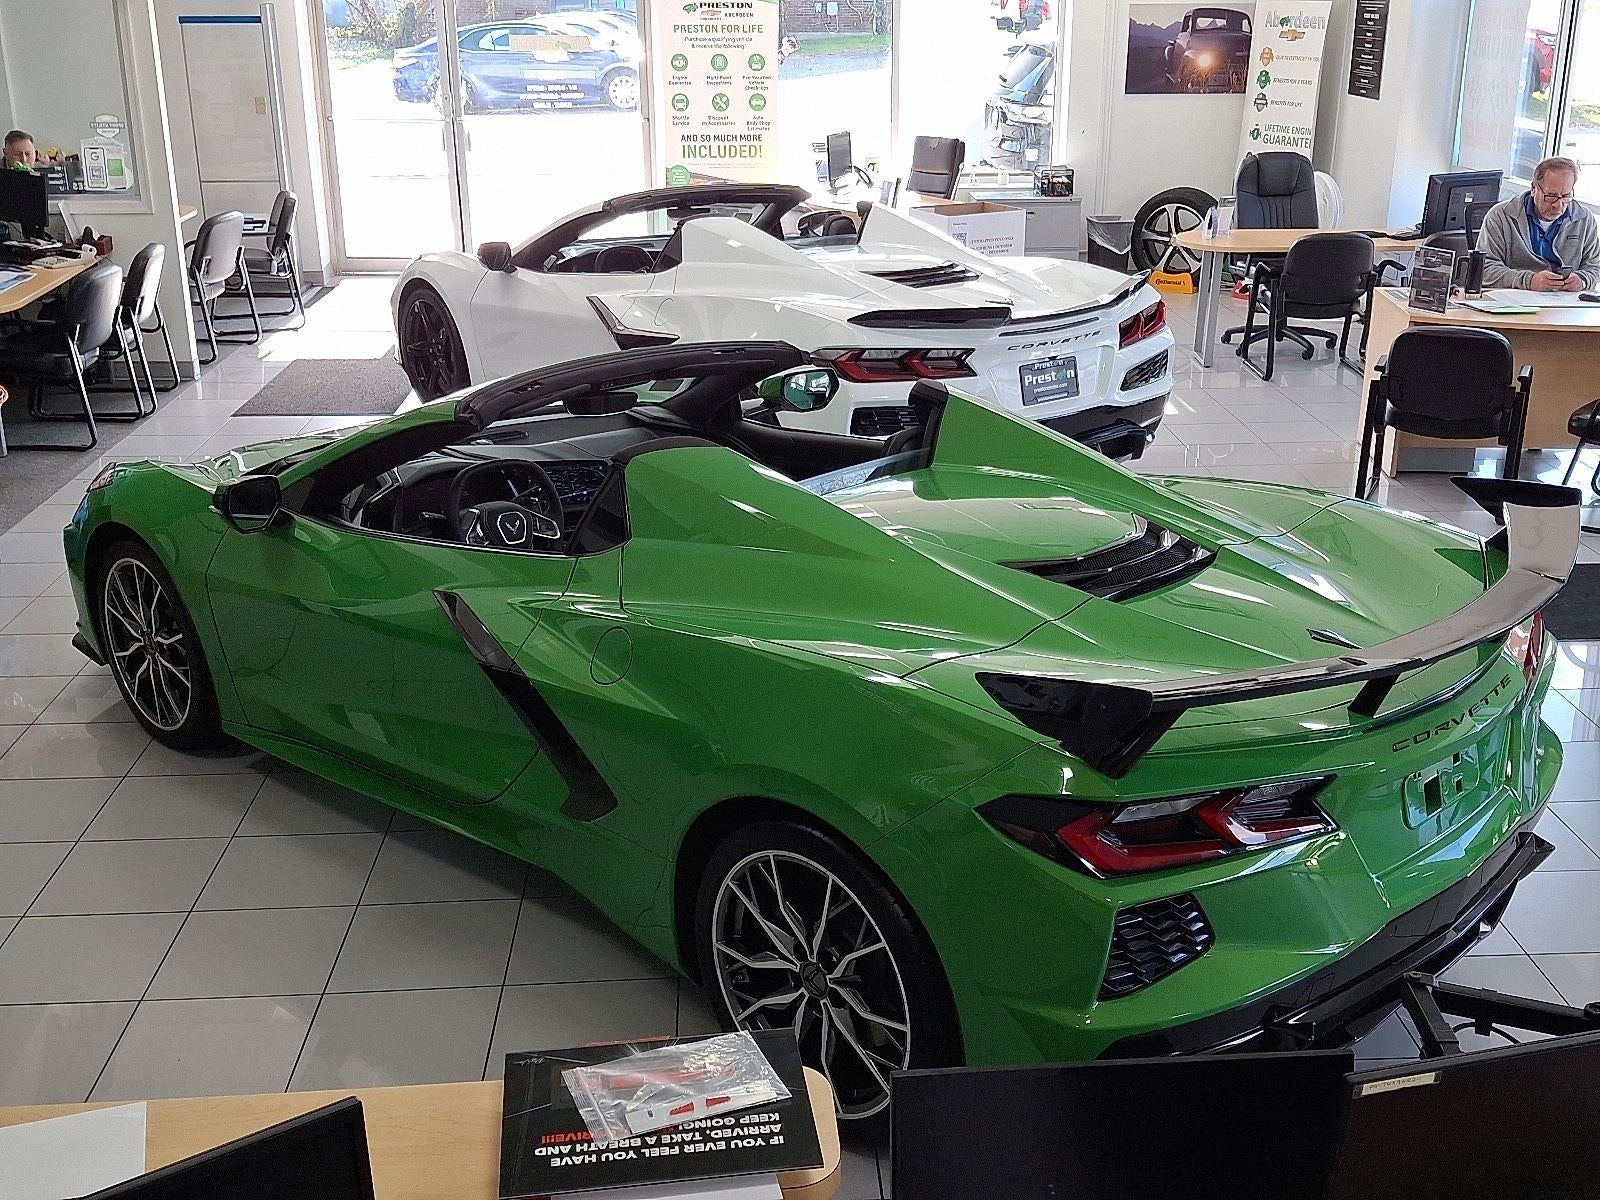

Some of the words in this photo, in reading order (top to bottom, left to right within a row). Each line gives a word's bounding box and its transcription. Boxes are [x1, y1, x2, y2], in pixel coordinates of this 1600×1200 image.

[1264, 10, 1326, 29] Abrdeen
[673, 24, 718, 34] PRESTON
[721, 24, 740, 34] FOR
[742, 24, 764, 34] LIFE
[1264, 124, 1291, 134] LIFETIME
[681, 134, 698, 142] AND
[700, 134, 711, 143] SO
[713, 134, 738, 142] MUCH
[739, 133, 763, 142] MORE
[682, 144, 762, 159] INCLUDED!
[1007, 330, 1101, 351] CORVETTE
[1034, 360, 1064, 370] Prestn
[1024, 369, 1075, 387] Prestn
[1392, 673, 1512, 753] CORVETTE
[678, 1117, 736, 1130] GOING!
[739, 1112, 780, 1124] KEEP
[644, 1136, 658, 1145] A
[660, 1131, 703, 1144] TAKE
[730, 1138, 766, 1149] YOU
[769, 1135, 784, 1145] IF
[534, 1144, 573, 1156] AND
[576, 1138, 642, 1153] BREATH
[640, 1145, 680, 1158] FEEL
[683, 1141, 726, 1153] EVER
[550, 1153, 597, 1167] HAVE
[601, 1150, 637, 1162] YOU
